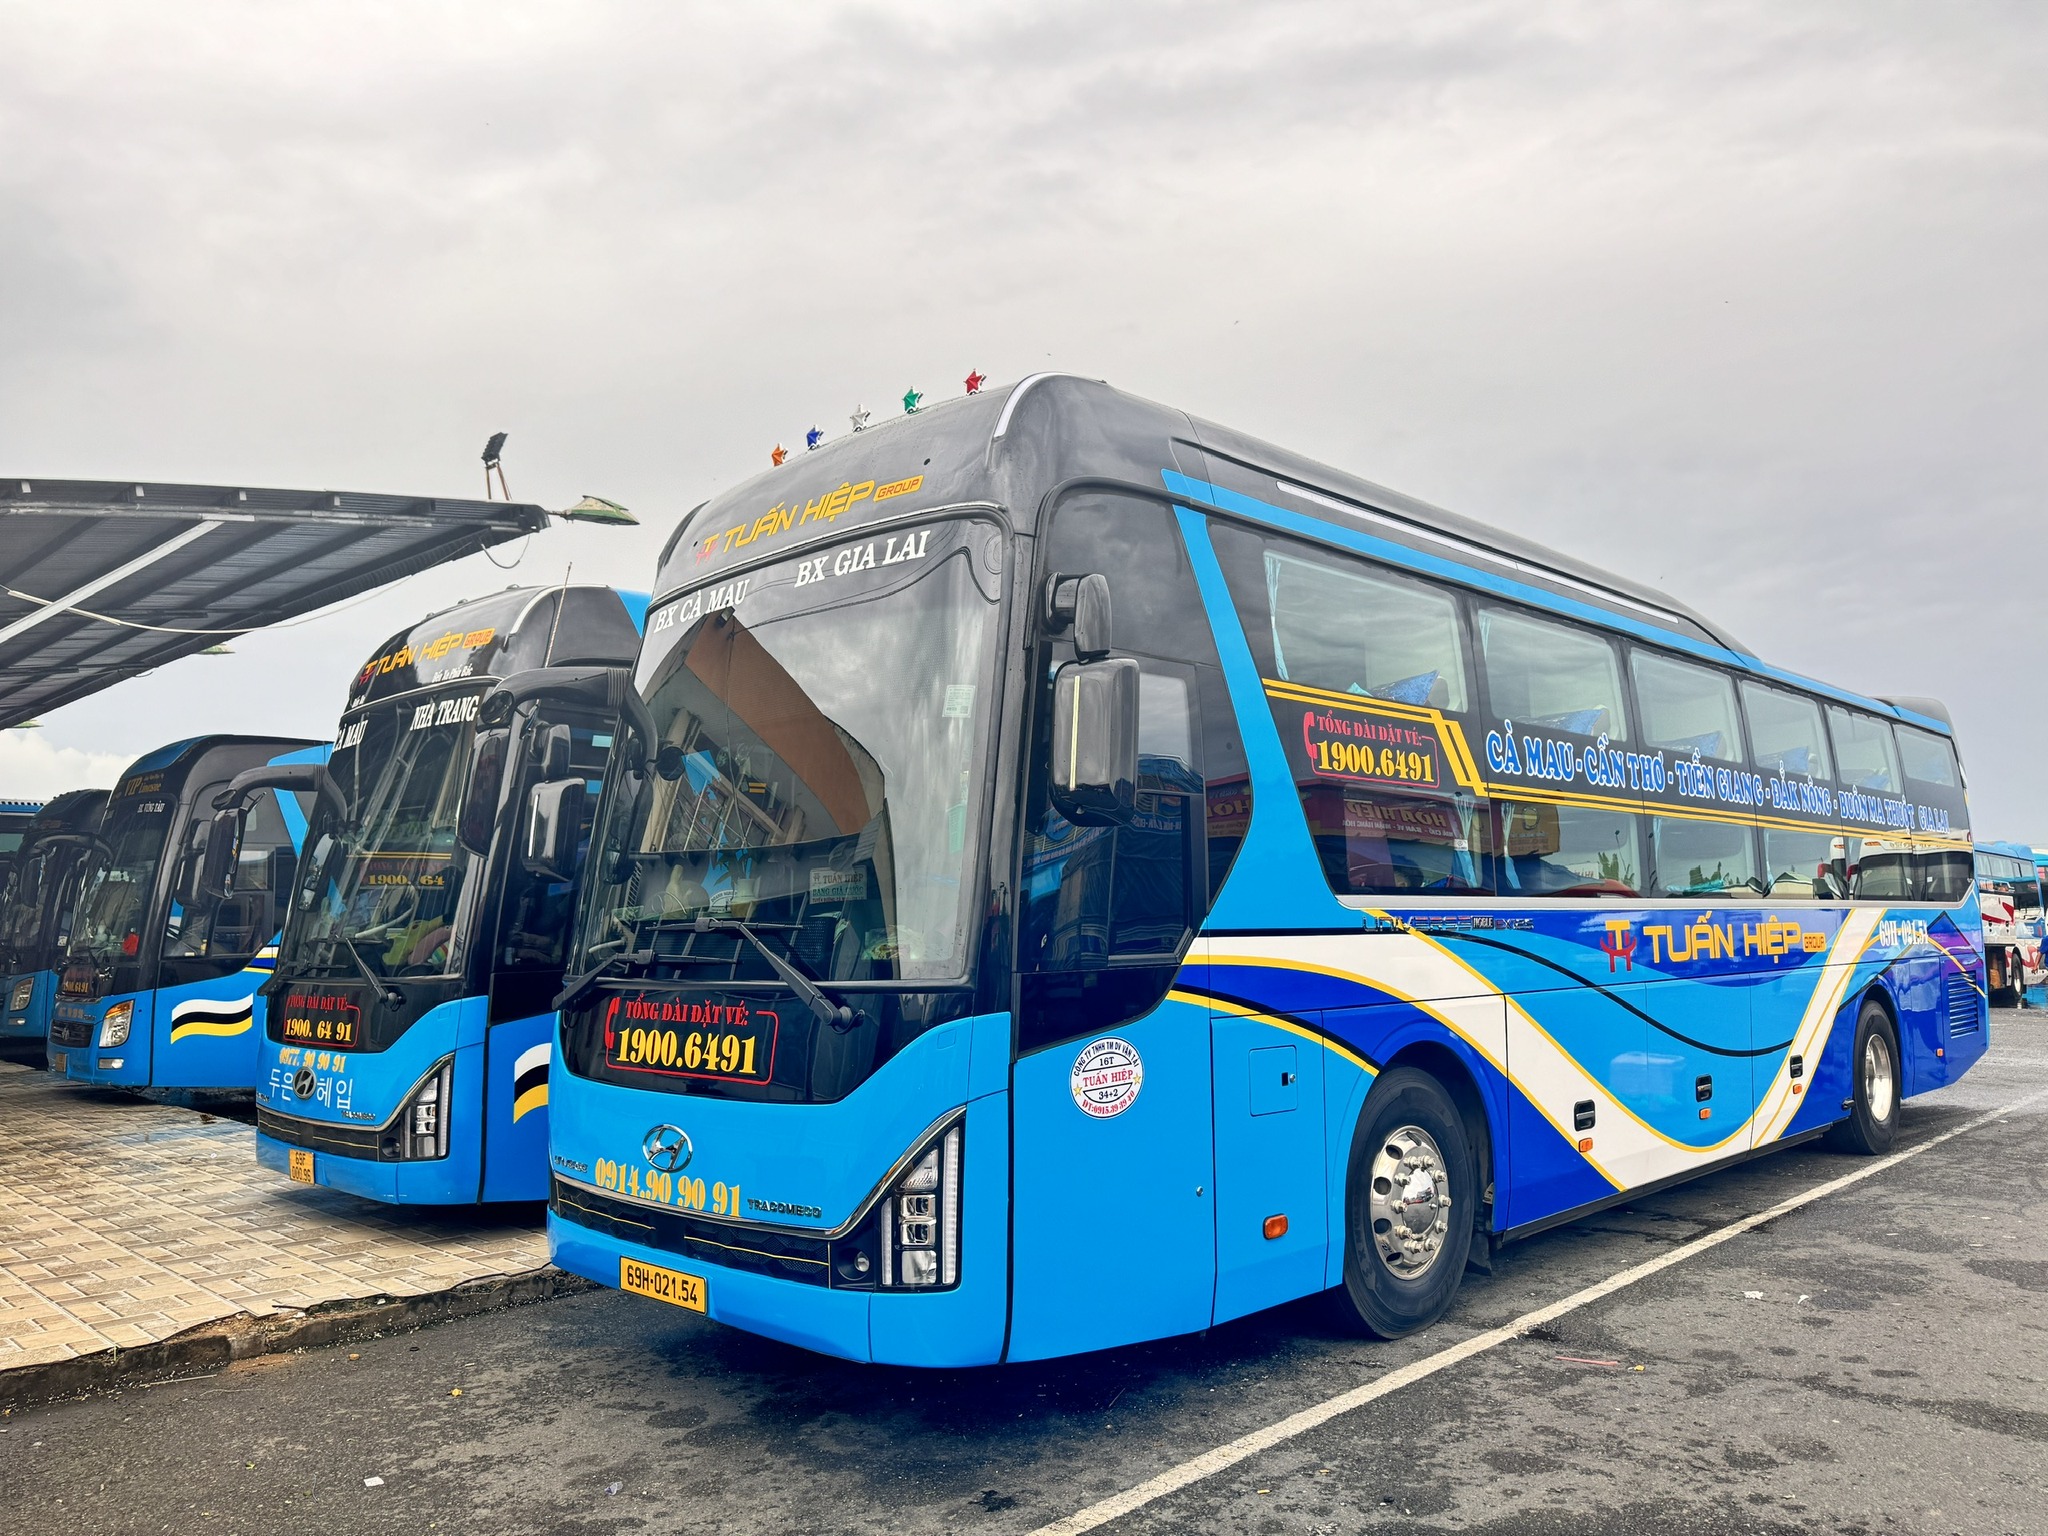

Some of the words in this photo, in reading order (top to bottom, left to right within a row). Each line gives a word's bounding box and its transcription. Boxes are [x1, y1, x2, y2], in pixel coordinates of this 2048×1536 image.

[723, 502, 799, 553] TUẤN
[799, 480, 875, 523] HIỆP
[878, 479, 920, 498] GROUP
[794, 556, 829, 588] BX
[833, 538, 876, 577] GIA
[882, 530, 931, 565] LAI
[654, 604, 679, 633] BX
[705, 579, 750, 614] MAU
[375, 641, 419, 676] TUẤN
[418, 631, 464, 662] HIỆP
[409, 702, 436, 731] NHA
[435, 695, 480, 726] TRANG
[1316, 710, 1351, 736] TỔNG
[1354, 719, 1376, 740] ĐÀI
[1379, 723, 1403, 746] ĐẶT
[1316, 740, 1434, 782] 1900.6491
[1716, 767, 1764, 807] GIANG
[1799, 775, 1832, 816] NÔNG
[1838, 784, 1869, 822] BUÔN
[1867, 796, 1886, 824] MA
[1918, 805, 1935, 832] GIA
[1934, 808, 1950, 834] LAI
[1643, 910, 1734, 964] TUẤN
[1743, 914, 1801, 964] HIỆP
[1804, 935, 1825, 951] GROUP
[285, 1018, 312, 1037] 1900.
[317, 1020, 332, 1039] 64
[336, 1022, 352, 1041] 91
[626, 993, 659, 1020] TỔNG
[661, 997, 688, 1022] ĐÀI
[690, 999, 723, 1027] ĐẶT
[332, 1054, 347, 1073] 91
[616, 1028, 757, 1074] 1900.6491
[1099, 1056, 1114, 1066] 16T
[1083, 1070, 1108, 1087] TUẤN
[1111, 1068, 1133, 1083] HIỆP
[1098, 1088, 1118, 1100] 34+2
[678, 1175, 706, 1211] 90
[712, 1181, 741, 1218] 91
[747, 1198, 822, 1219] TRACOMECO
[626, 1264, 698, 1305] 69H-021.54
